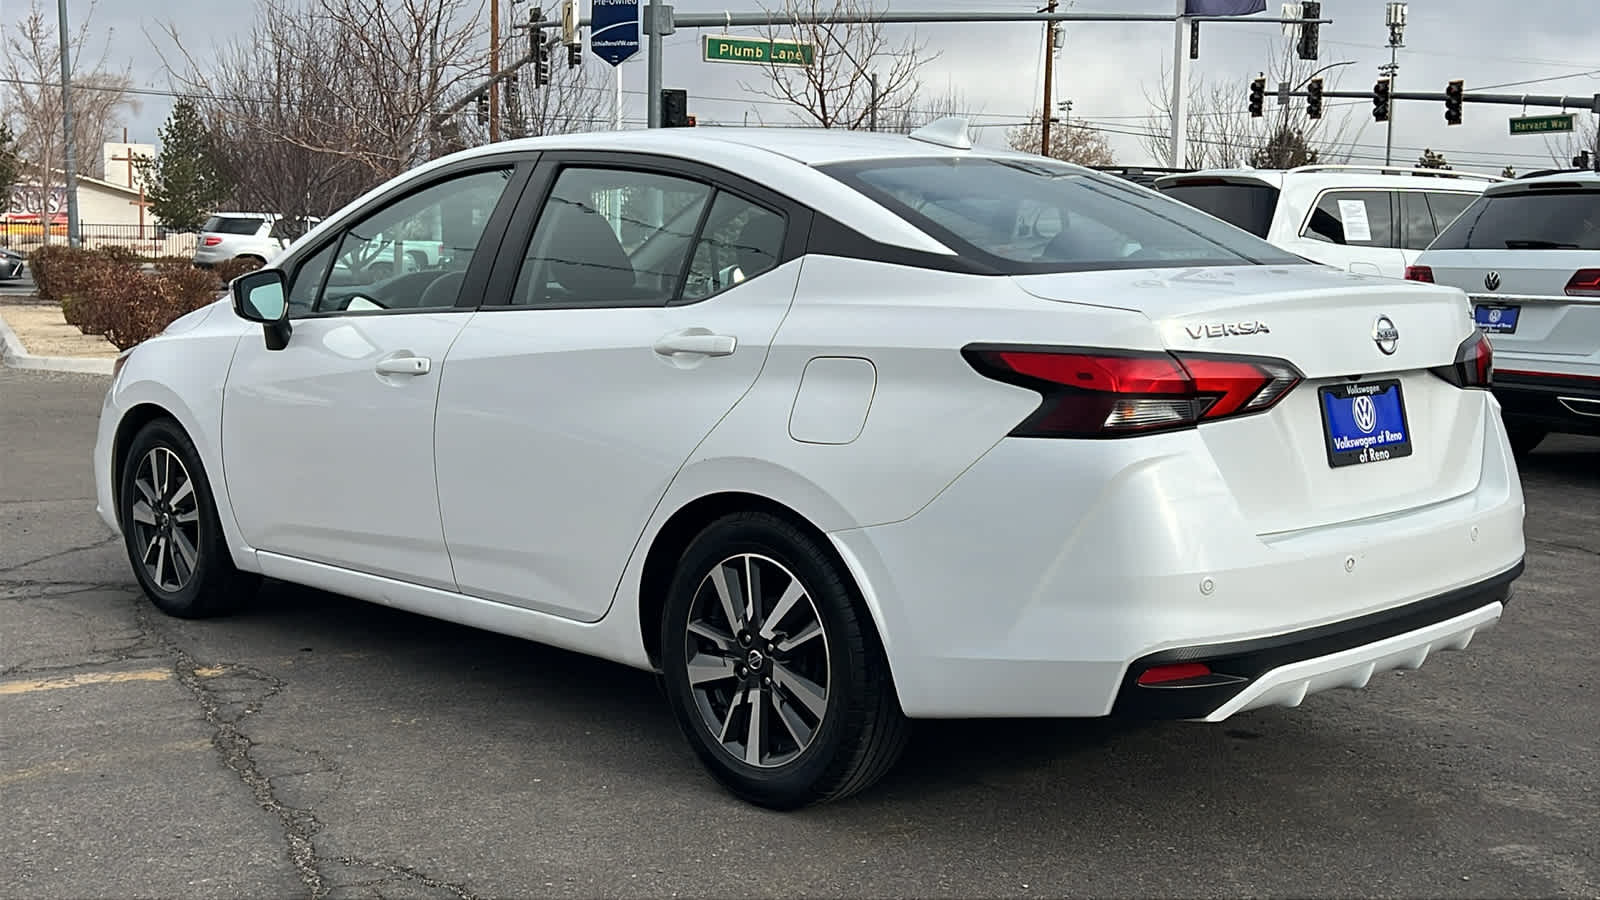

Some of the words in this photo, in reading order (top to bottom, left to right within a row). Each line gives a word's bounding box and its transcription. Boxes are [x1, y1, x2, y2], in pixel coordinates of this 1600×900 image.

[719, 43, 763, 58] Plumb
[771, 48, 802, 60] Lane
[1514, 121, 1547, 131] Harvard
[1551, 119, 1569, 129] Way
[1185, 321, 1270, 340] VERSA
[1346, 384, 1381, 395] Volkswagen
[1334, 435, 1377, 450] Volkswagen
[1377, 431, 1385, 443] of
[1384, 430, 1402, 442] Reno
[1359, 448, 1369, 463] of
[1368, 447, 1390, 462] Reno
